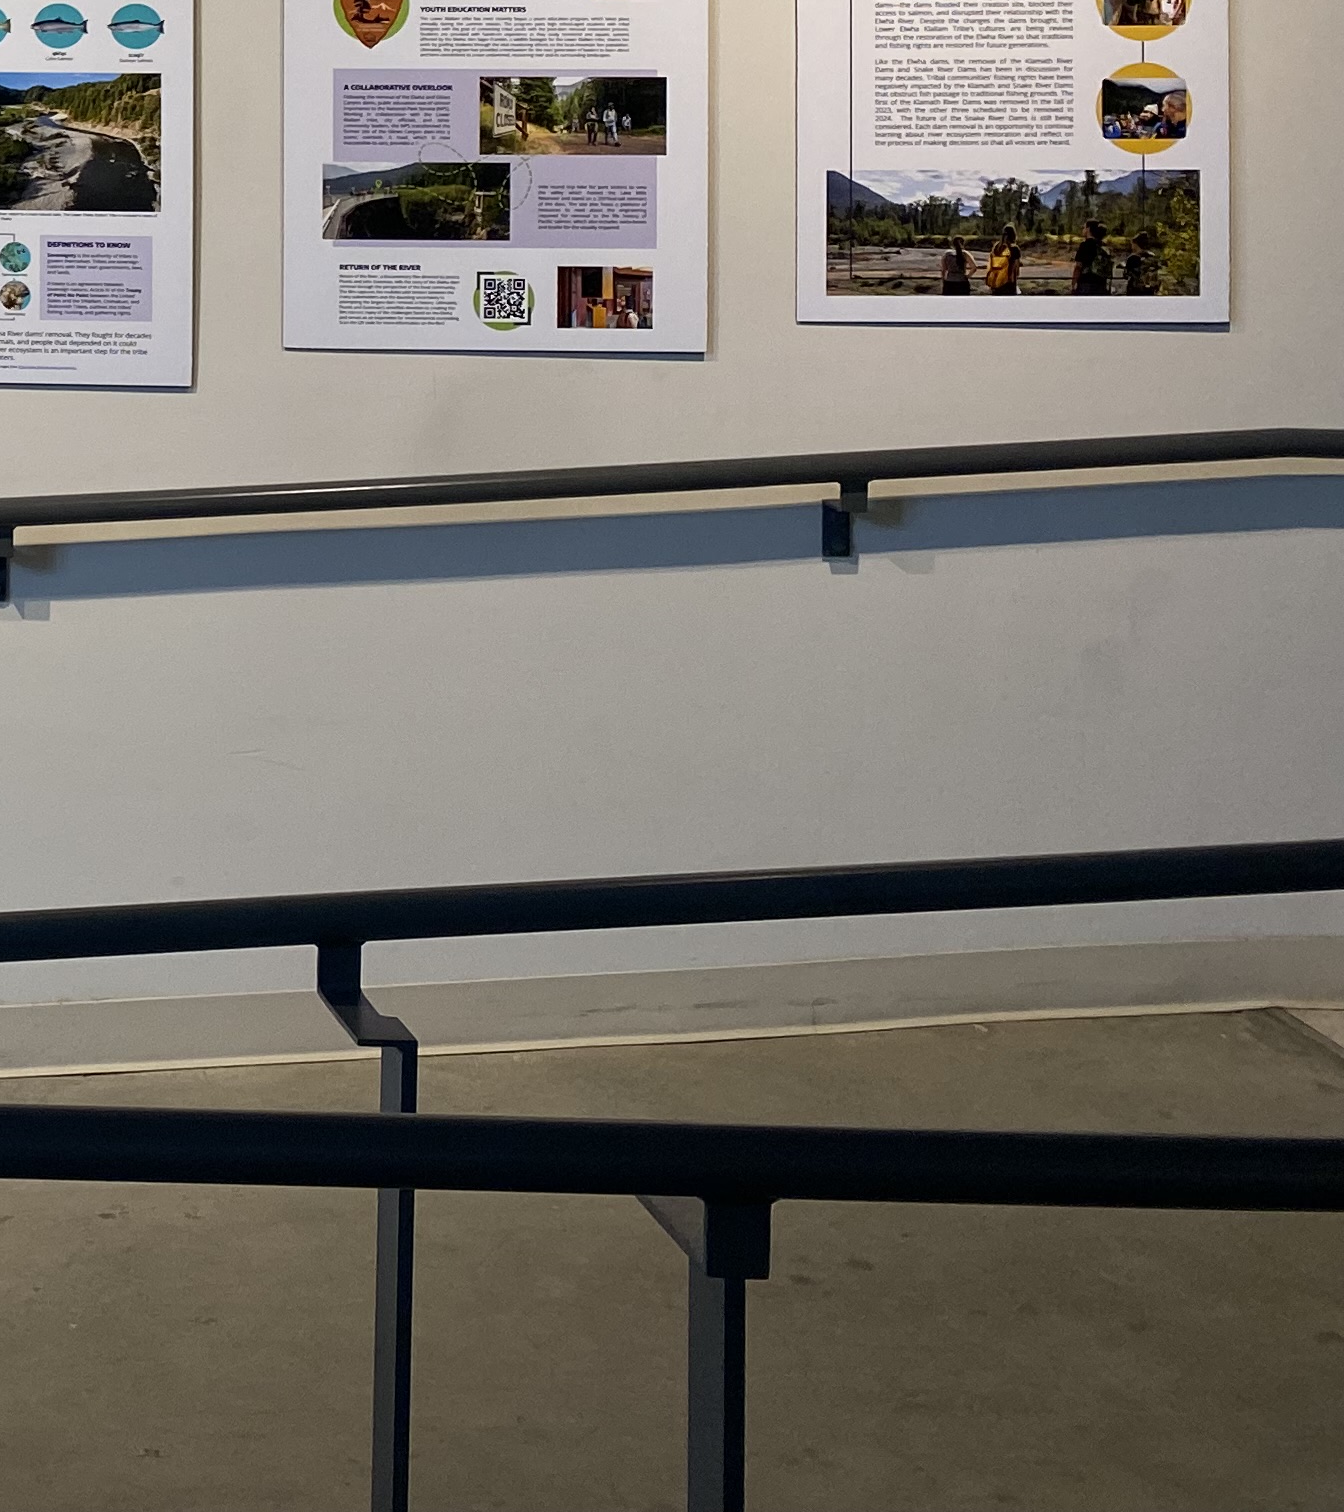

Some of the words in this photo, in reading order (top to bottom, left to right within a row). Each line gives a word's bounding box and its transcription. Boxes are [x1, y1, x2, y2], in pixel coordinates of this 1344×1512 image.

[411, 84, 454, 92] OVERLOOK
[94, 241, 106, 249] TO
[339, 263, 370, 271] RETURN
